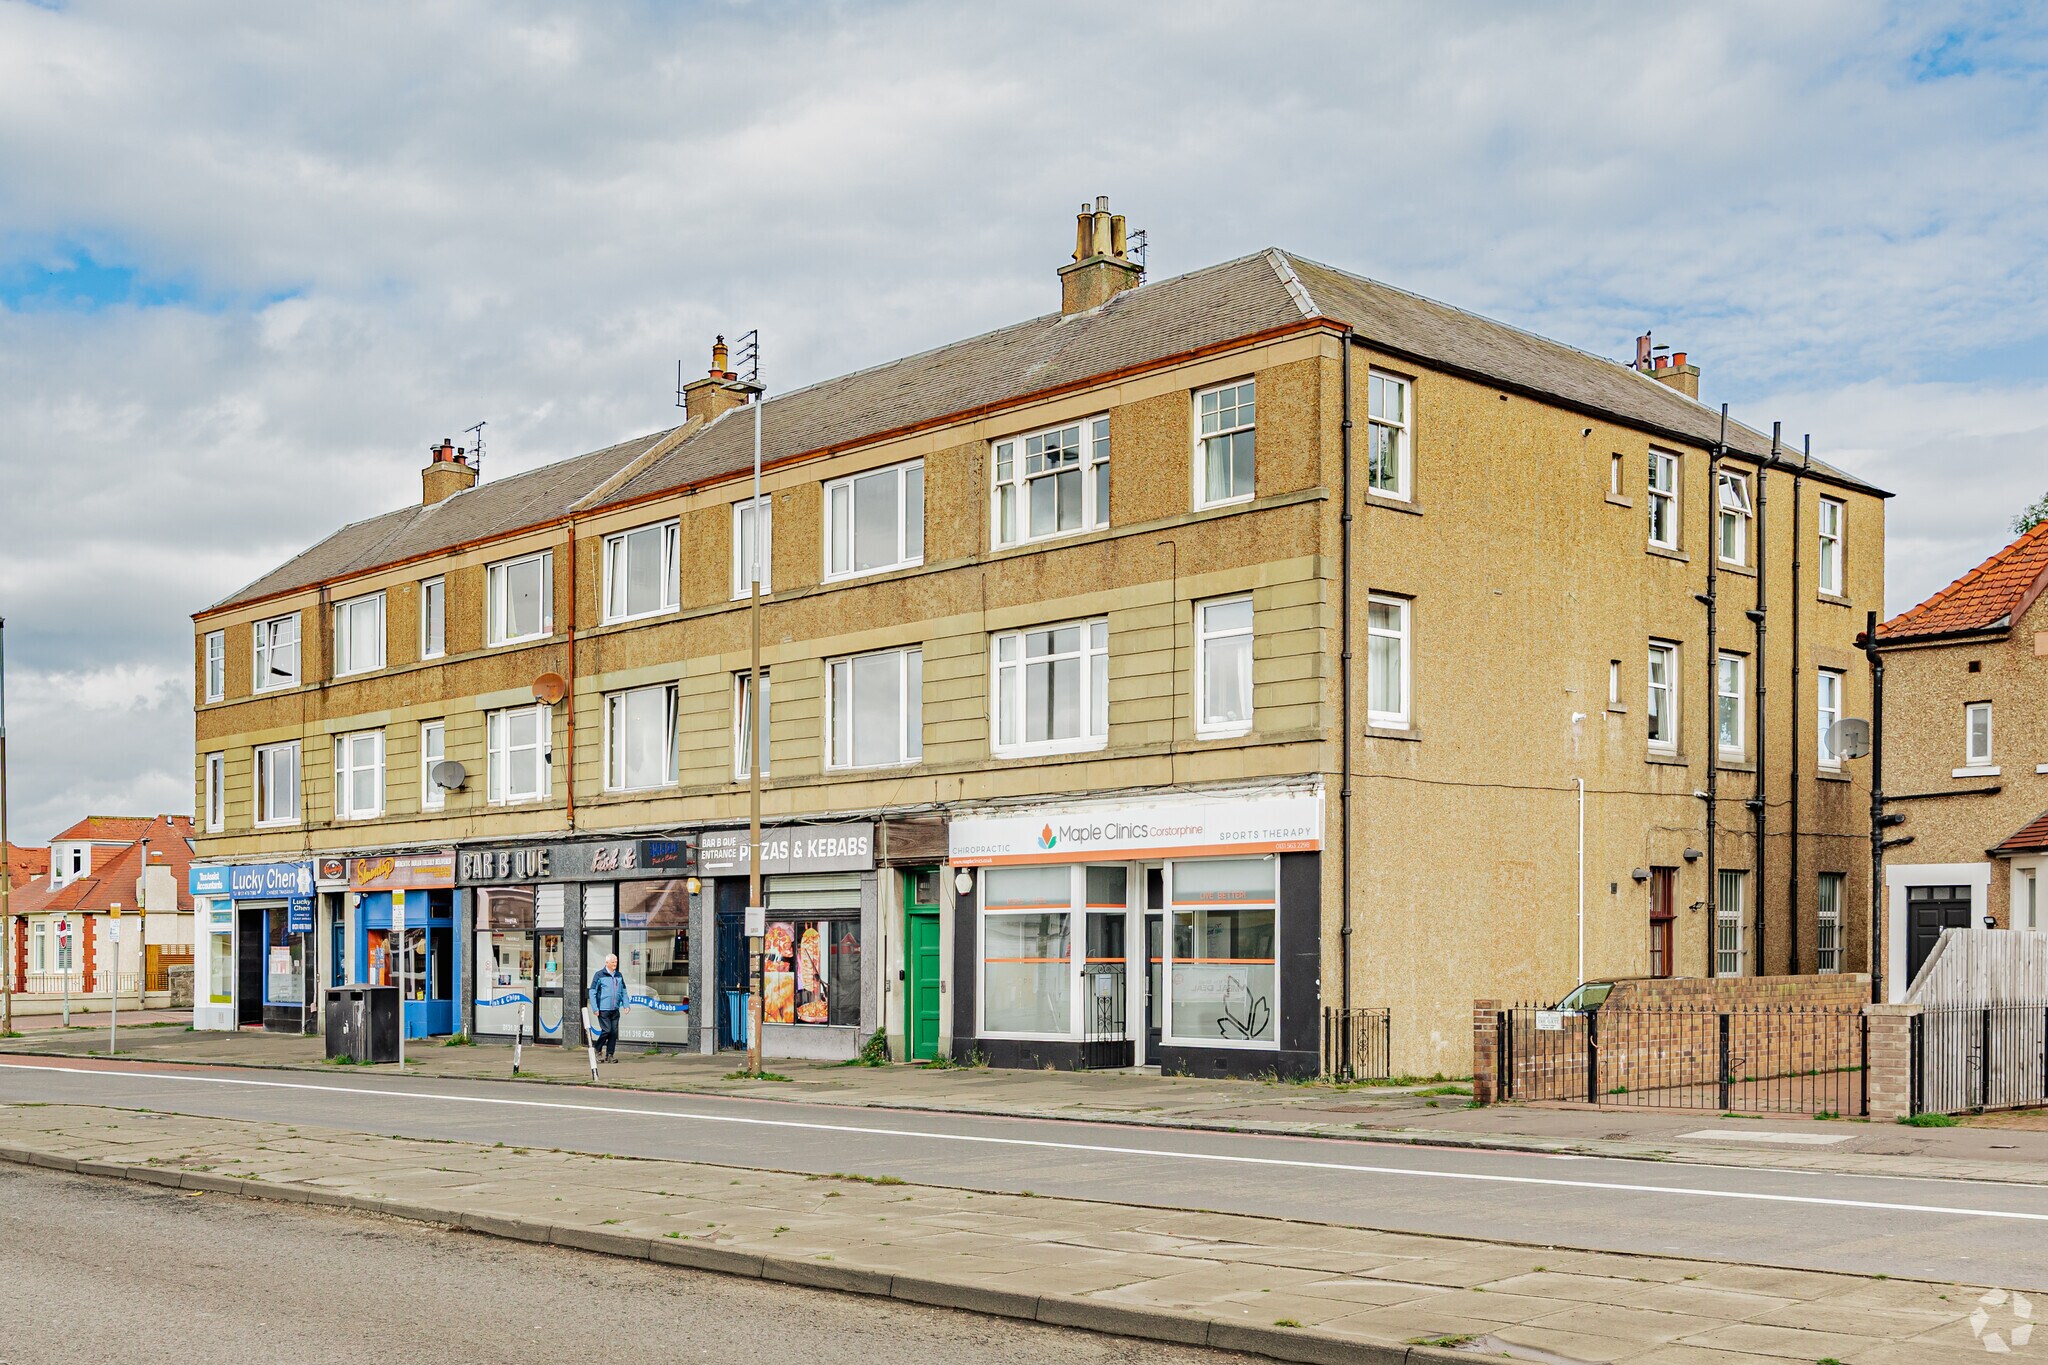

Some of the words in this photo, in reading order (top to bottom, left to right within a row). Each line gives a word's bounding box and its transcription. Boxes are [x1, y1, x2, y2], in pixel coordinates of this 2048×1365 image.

[1059, 824, 1102, 844] Maple
[1105, 822, 1148, 840] Clinics
[1149, 825, 1203, 838] Corstorphine
[1219, 831, 1259, 841] SPORTS
[1263, 828, 1311, 839] THERAPY
[702, 838, 716, 848] BAR
[716, 838, 722, 847] B
[722, 837, 737, 847] QUE
[739, 840, 789, 862] PIZAS
[793, 840, 803, 858] &
[807, 836, 868, 858] KEBABS
[701, 848, 737, 860] ENTRANCE
[952, 844, 1011, 855] CHIROPRACTIC
[462, 851, 493, 879] BAR
[499, 850, 511, 878] B
[515, 848, 550, 879] QUE
[592, 847, 619, 873] Fish
[622, 847, 637, 869] &
[196, 881, 223, 890] Accountants
[232, 869, 264, 894] Lucky
[266, 868, 296, 889] Chen
[292, 898, 312, 906] Lucky
[505, 994, 520, 1003] Chips
[629, 996, 647, 1004] Pizzas
[654, 1002, 676, 1011] Kebabs
